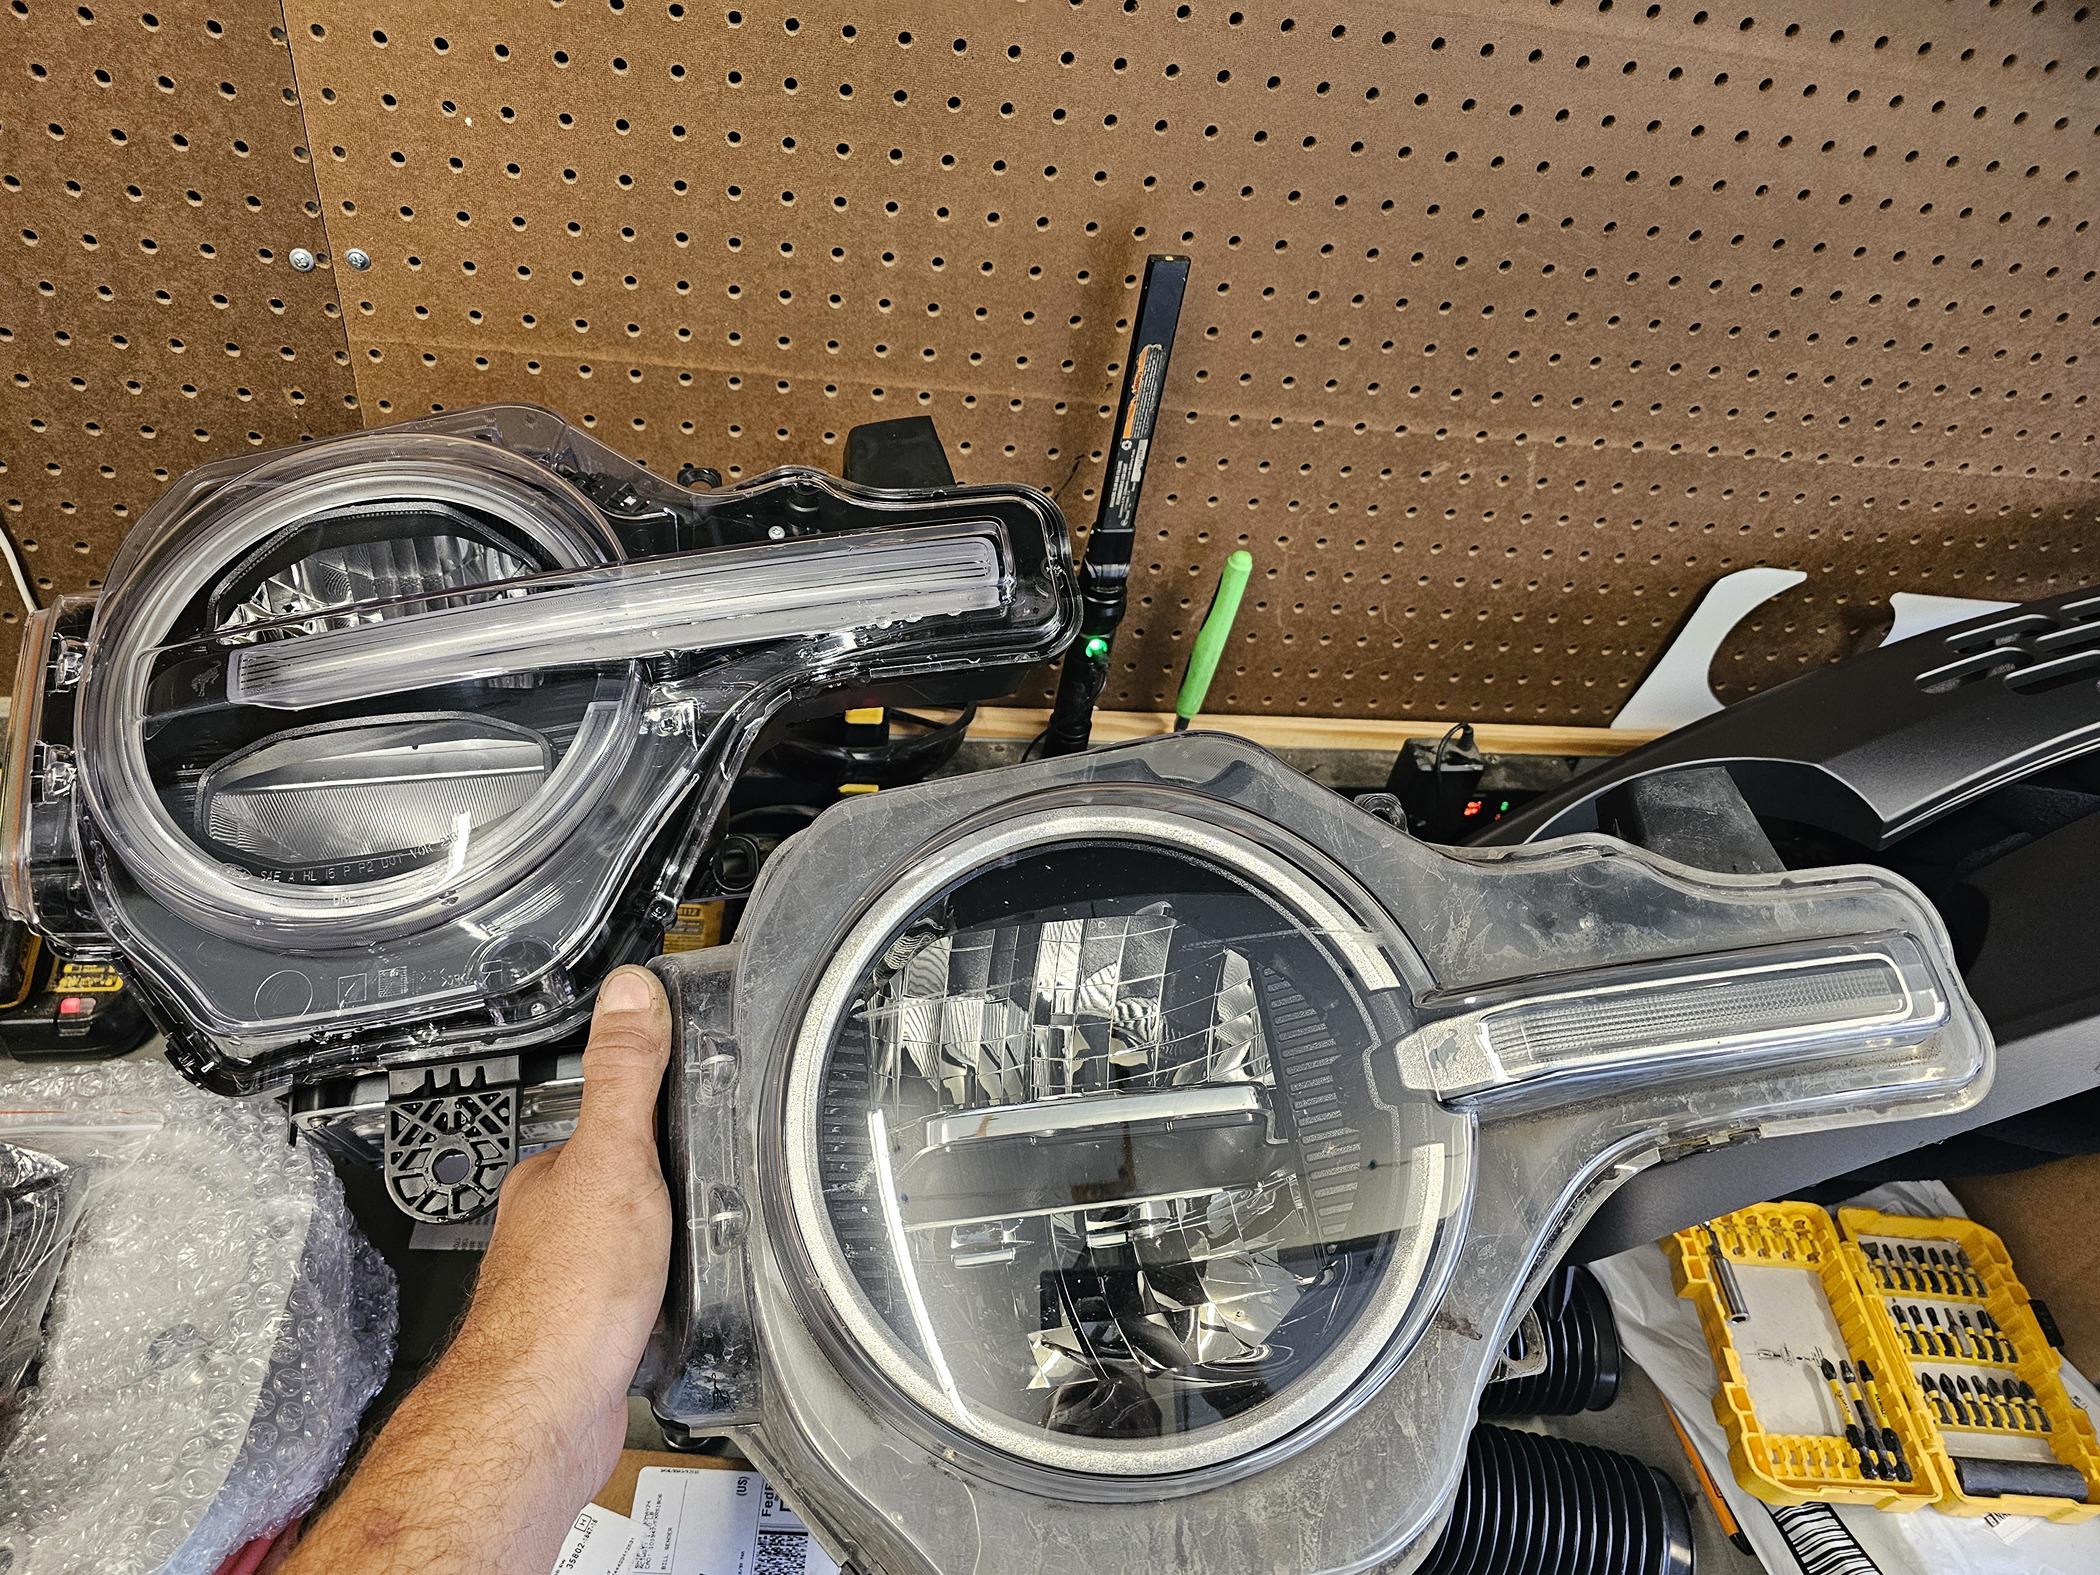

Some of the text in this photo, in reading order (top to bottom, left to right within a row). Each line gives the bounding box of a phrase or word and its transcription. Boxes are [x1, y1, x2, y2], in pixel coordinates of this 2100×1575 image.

[260, 870, 282, 882] SAE
[288, 871, 296, 882] A
[303, 870, 318, 882] HL
[343, 865, 351, 877] P
[358, 861, 375, 874] P2
[736, 1476, 750, 1497] (US)
[761, 1482, 775, 1517] FedE
